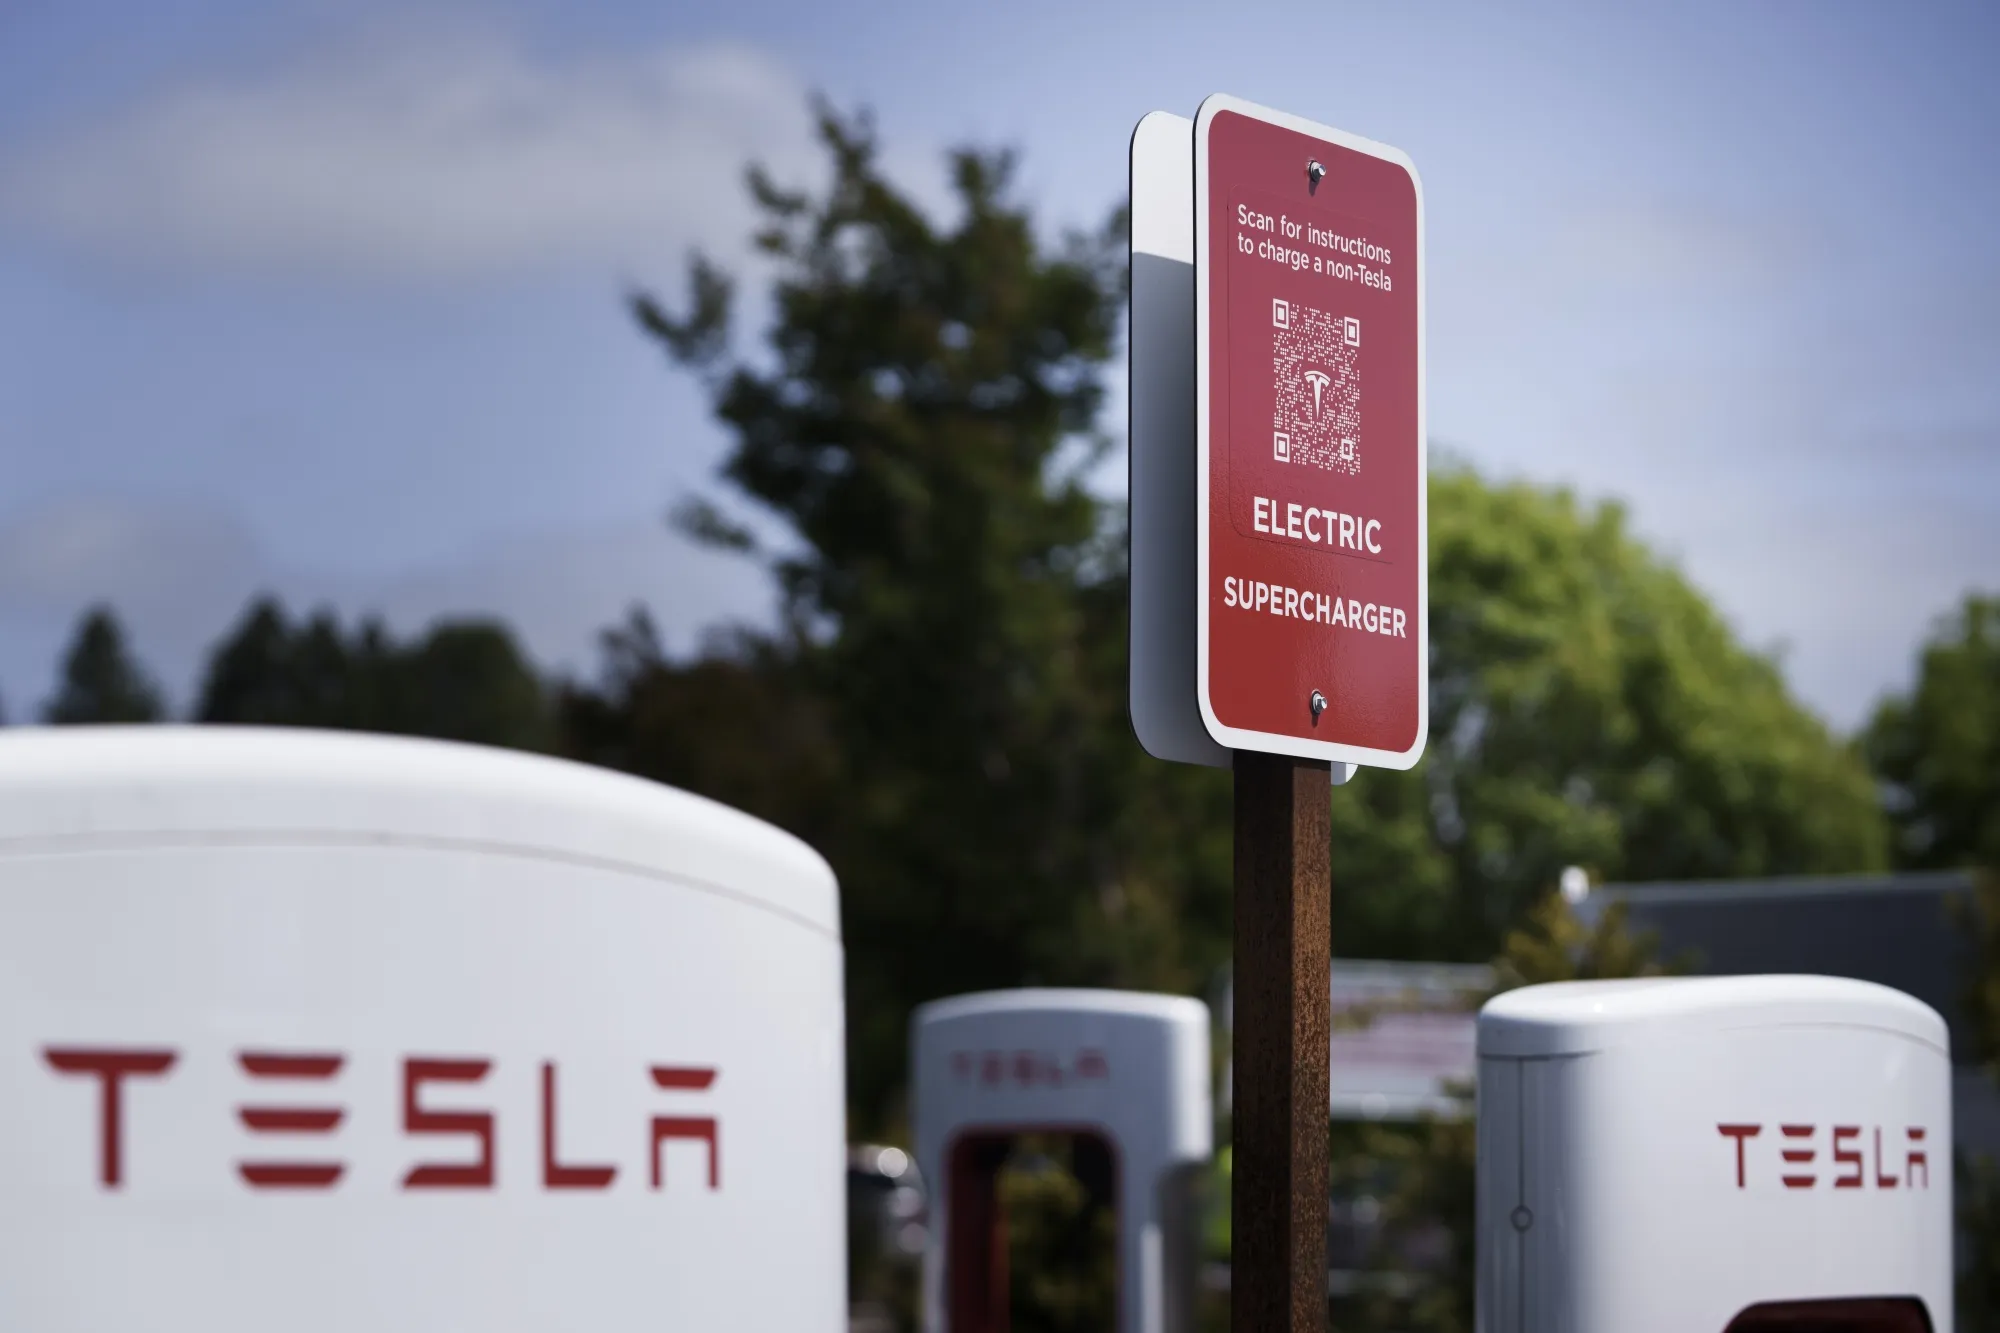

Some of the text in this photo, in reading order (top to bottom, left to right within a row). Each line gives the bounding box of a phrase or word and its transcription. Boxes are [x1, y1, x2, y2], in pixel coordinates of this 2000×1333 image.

[1237, 204, 1391, 264] Scan for instructions
[1237, 232, 1392, 291] to charge a non-Tesla
[1253, 496, 1382, 554] ELECTRIC
[1224, 576, 1406, 638] SUPERCHARGER
[40, 1046, 720, 1191] TESLA
[1717, 1122, 1928, 1189] TESLA
